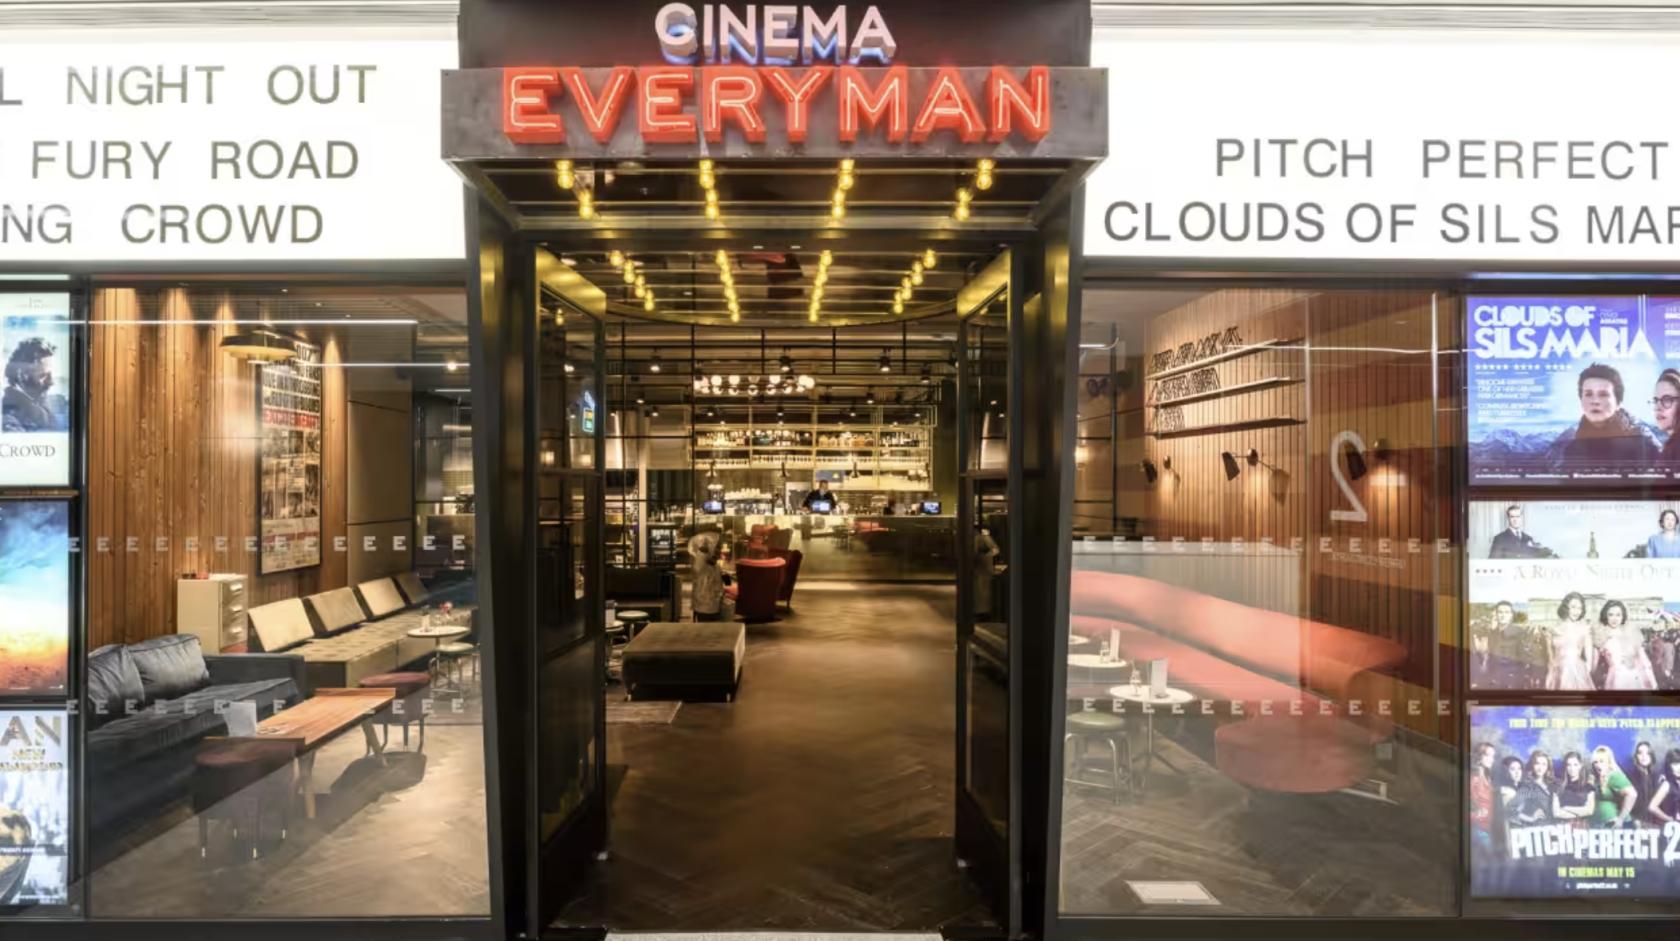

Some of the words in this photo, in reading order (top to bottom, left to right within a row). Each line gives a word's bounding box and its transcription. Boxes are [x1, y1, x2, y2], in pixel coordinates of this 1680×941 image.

[655, 3, 896, 61] CINEMA
[67, 65, 225, 105] NIGHT
[267, 65, 376, 105] OUT
[503, 66, 1050, 144] EVERYMAN
[32, 140, 172, 180] FURY
[211, 139, 358, 180] ROAD
[1216, 137, 1373, 179] PITCH
[1422, 139, 1668, 181] PERFECT
[1, 204, 72, 244] NG
[120, 203, 323, 244] CROWD
[1103, 200, 1325, 243] CLOUDS
[1345, 202, 1417, 243] OF
[1439, 203, 1559, 244] SILS
[1474, 305, 1563, 327] CLOUDS
[1564, 305, 1596, 327] OF
[1474, 327, 1537, 359] SILS
[1539, 327, 1658, 359] MARIA
[1510, 823, 1573, 859] PITCH
[1573, 828, 1661, 859] PERFECT
[1568, 867, 1604, 878] CINEMAS
